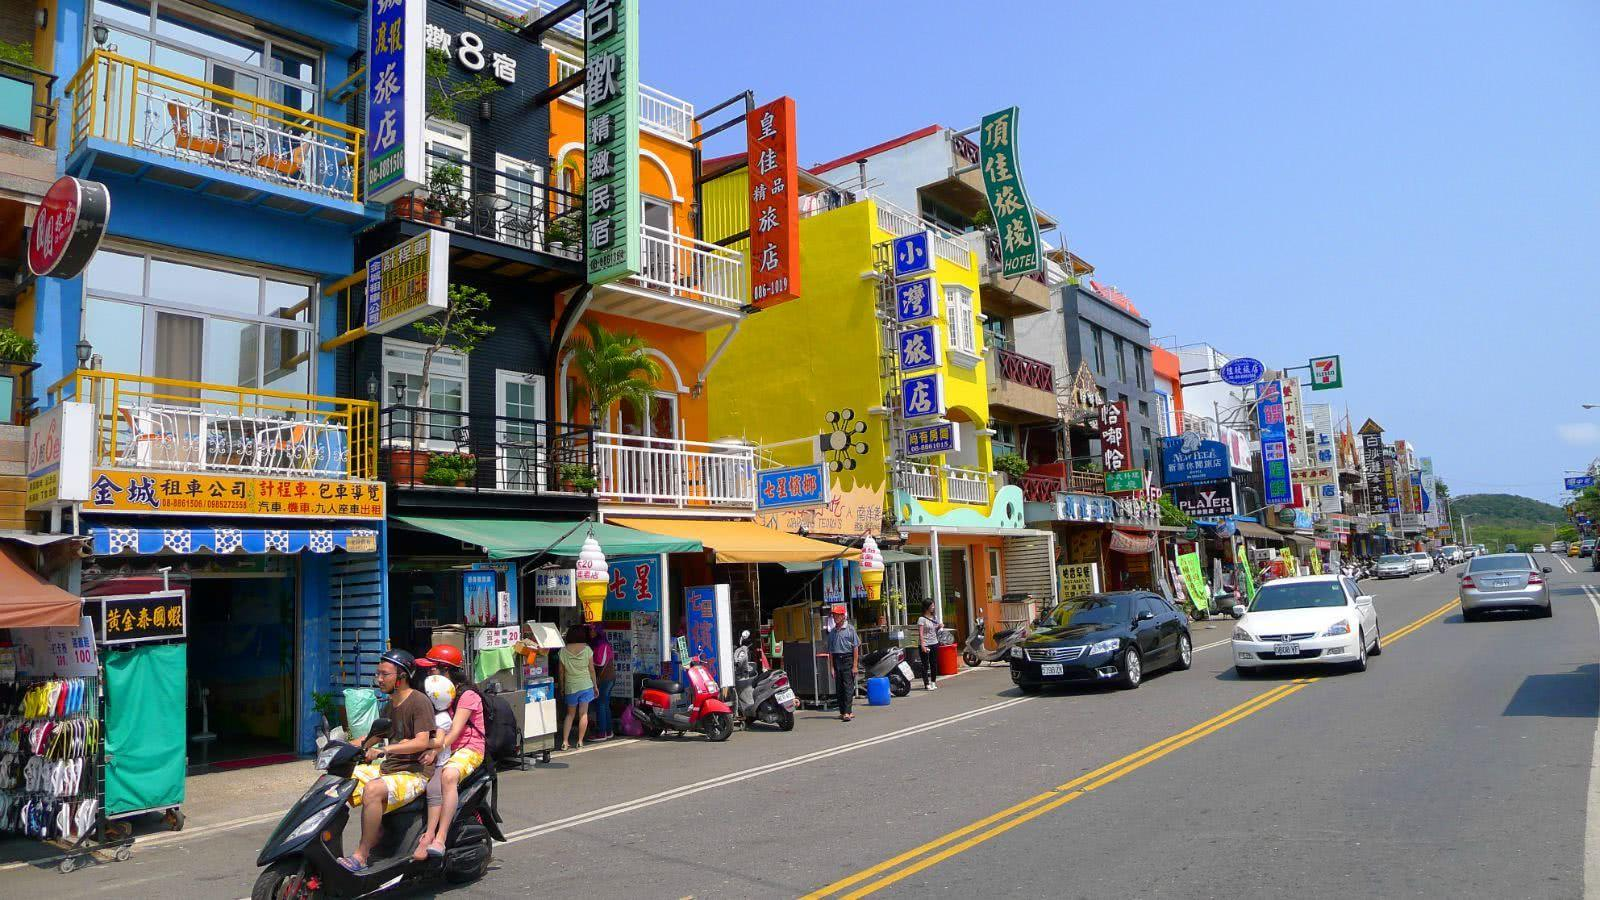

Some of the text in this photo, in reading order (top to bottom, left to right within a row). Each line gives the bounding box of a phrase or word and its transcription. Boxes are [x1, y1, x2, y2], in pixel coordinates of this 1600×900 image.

[1004, 253, 1036, 272] HOTEL
[1180, 491, 1230, 511] PLAYER
[509, 631, 518, 641] 20
[75, 649, 91, 664] 100
